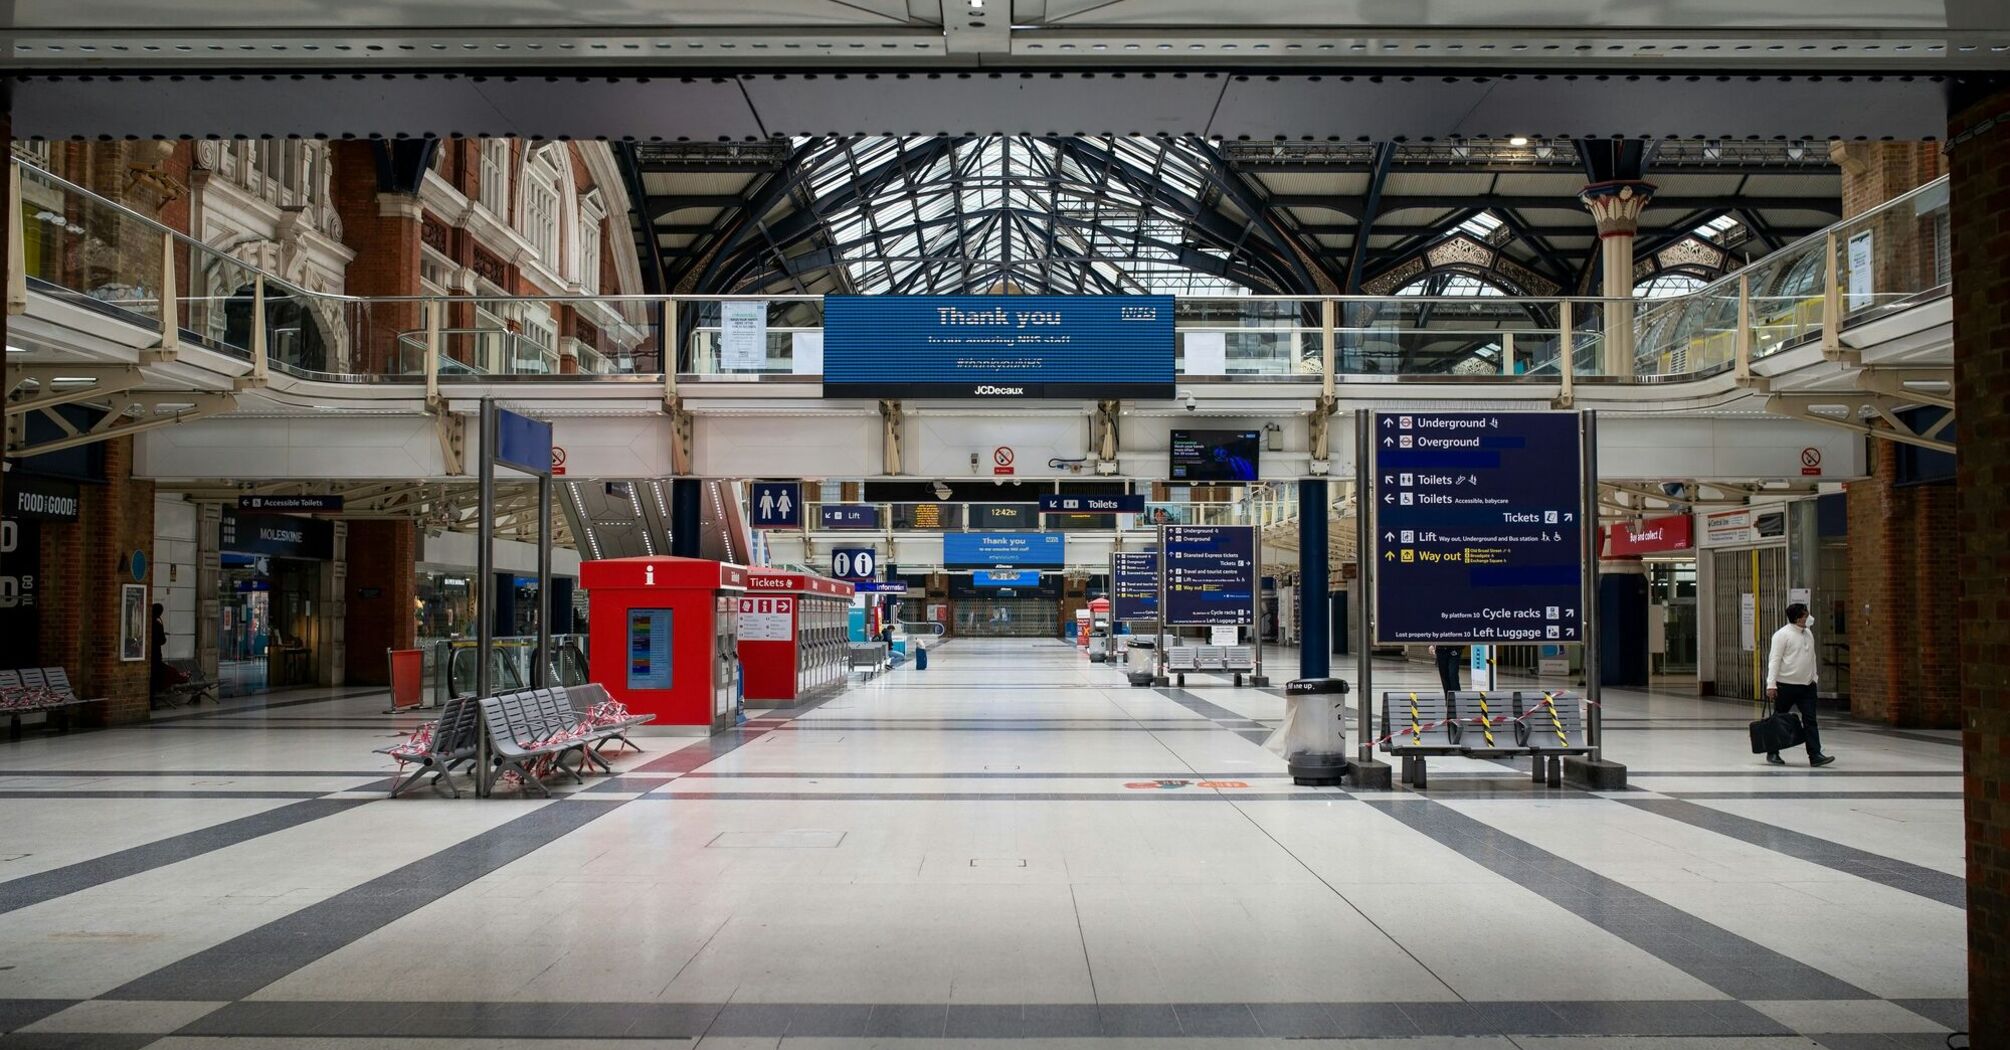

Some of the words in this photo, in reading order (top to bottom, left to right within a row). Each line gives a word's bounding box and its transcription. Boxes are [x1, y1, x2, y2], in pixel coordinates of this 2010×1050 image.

[937, 307, 1009, 325] Thank
[1016, 311, 1061, 328] you
[974, 385, 1023, 395] JCDecaux
[1418, 417, 1486, 430] Underground
[1418, 437, 1479, 448] Overground
[1418, 475, 1452, 485] Toilets
[18, 492, 44, 512] FOOD
[1418, 494, 1452, 504] Toilets
[48, 495, 73, 516] GOOD
[1088, 500, 1118, 509] Toilets
[1503, 513, 1540, 523] Tickets
[982, 537, 1008, 545] Thank
[1009, 538, 1026, 546] you
[1419, 532, 1437, 542] Lift
[1419, 551, 1441, 562] Way
[1443, 551, 1461, 561] out
[750, 577, 784, 587] Tickets
[1482, 608, 1511, 619] Cycle
[1513, 608, 1541, 618] racks
[1406, 631, 1431, 639] property
[1432, 631, 1439, 639] by
[1440, 631, 1463, 639] platform
[1473, 627, 1495, 637] Left
[1497, 628, 1541, 639] Luggage
